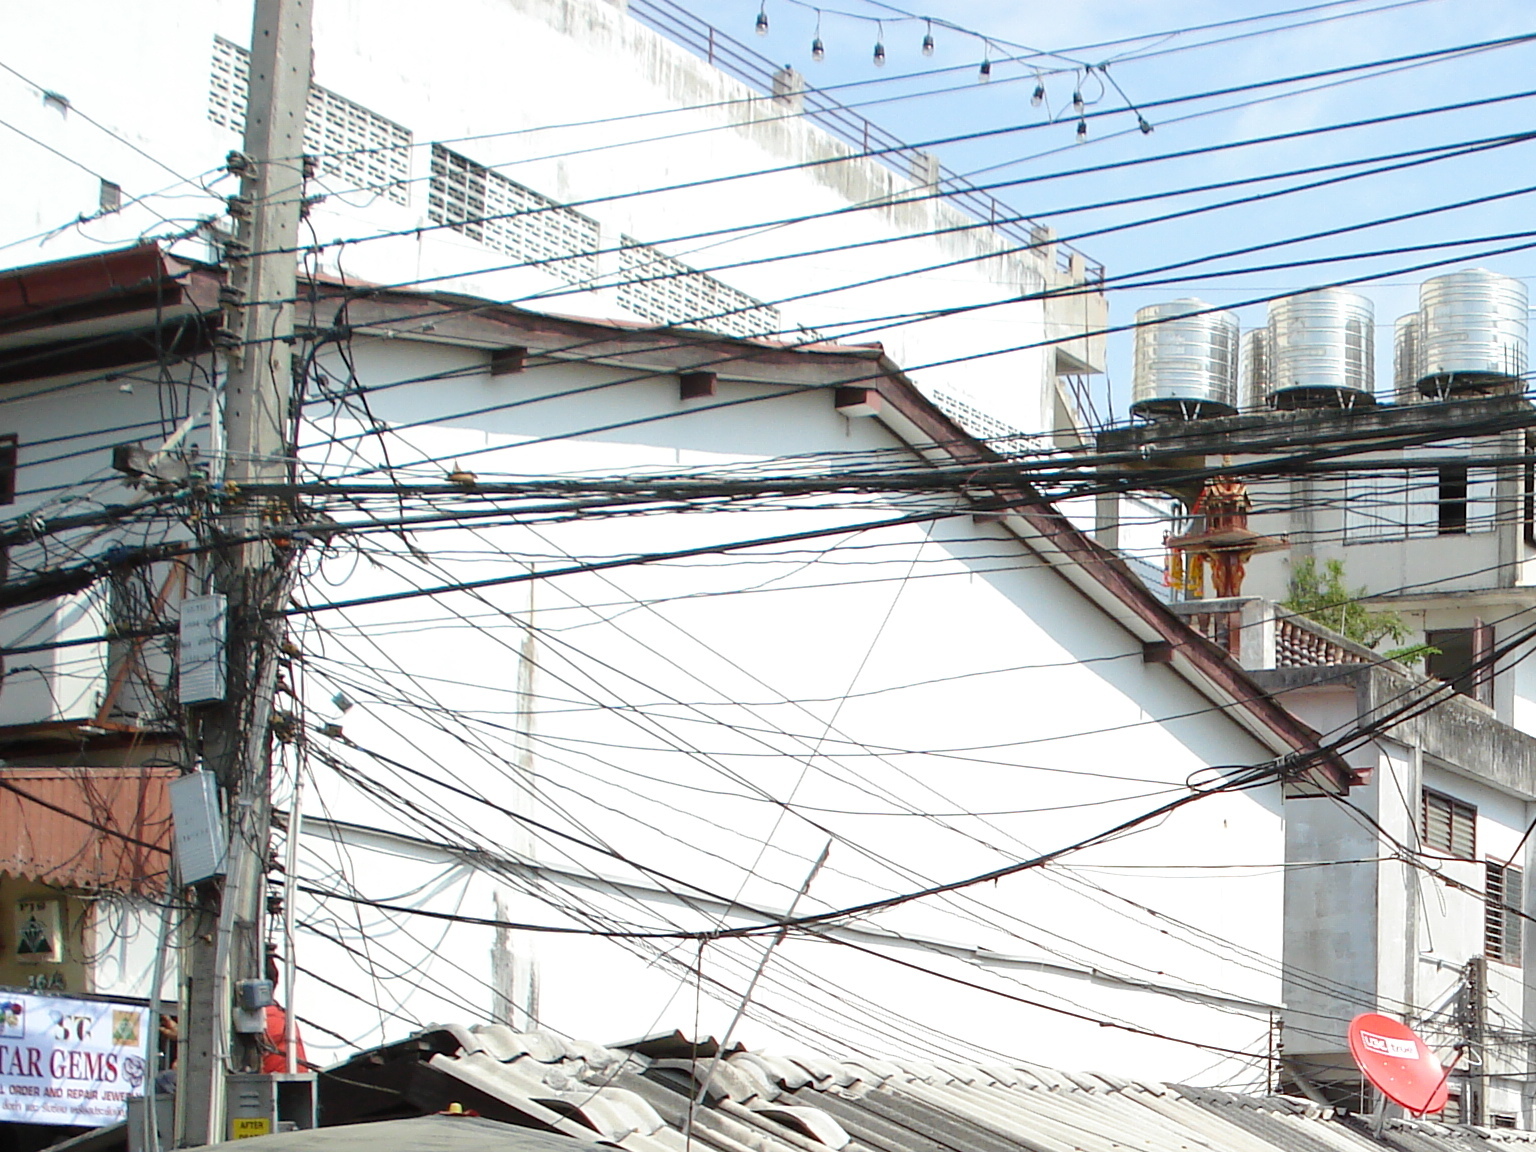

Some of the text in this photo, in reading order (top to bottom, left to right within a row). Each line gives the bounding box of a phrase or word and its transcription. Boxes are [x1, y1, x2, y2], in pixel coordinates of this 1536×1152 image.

[50, 1048, 118, 1083] GEMS
[9, 1085, 40, 1097] ORDER
[43, 1087, 63, 1098] AND
[66, 1088, 98, 1100] REPAIR
[240, 1120, 264, 1129] AFTER
